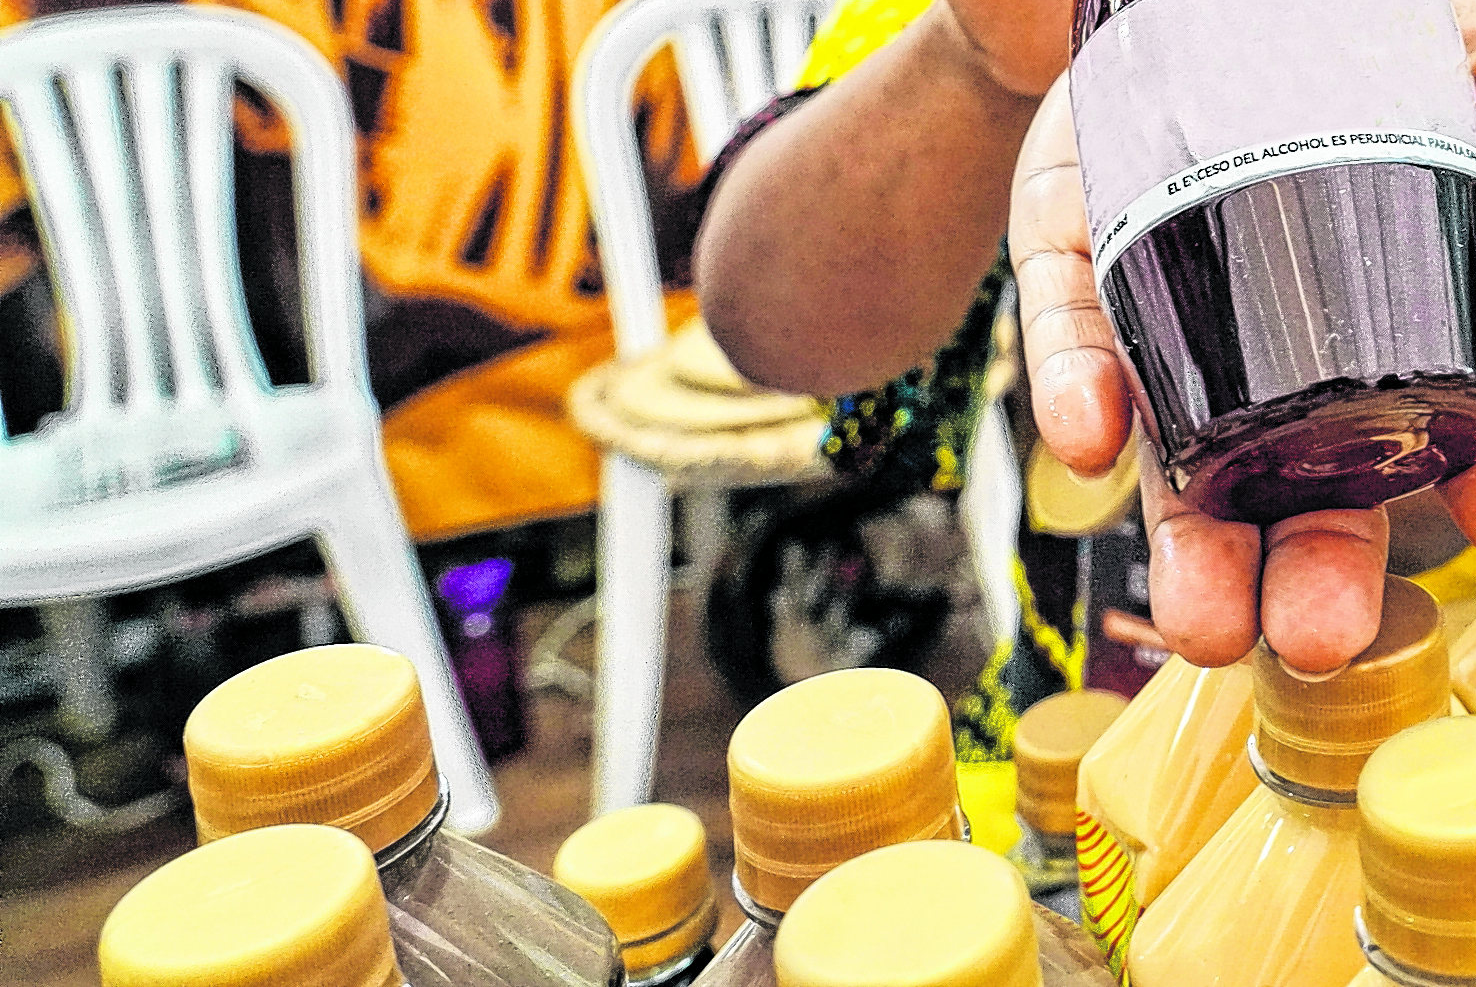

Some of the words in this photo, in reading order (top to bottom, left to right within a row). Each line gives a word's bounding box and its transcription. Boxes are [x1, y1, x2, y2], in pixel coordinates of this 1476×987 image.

[1168, 182, 1181, 195] EL
[1233, 152, 1259, 168] DEL
[1262, 137, 1329, 160] ALCOHOL
[1331, 134, 1347, 146] ES
[1350, 133, 1426, 147] PERJUDICIAL
